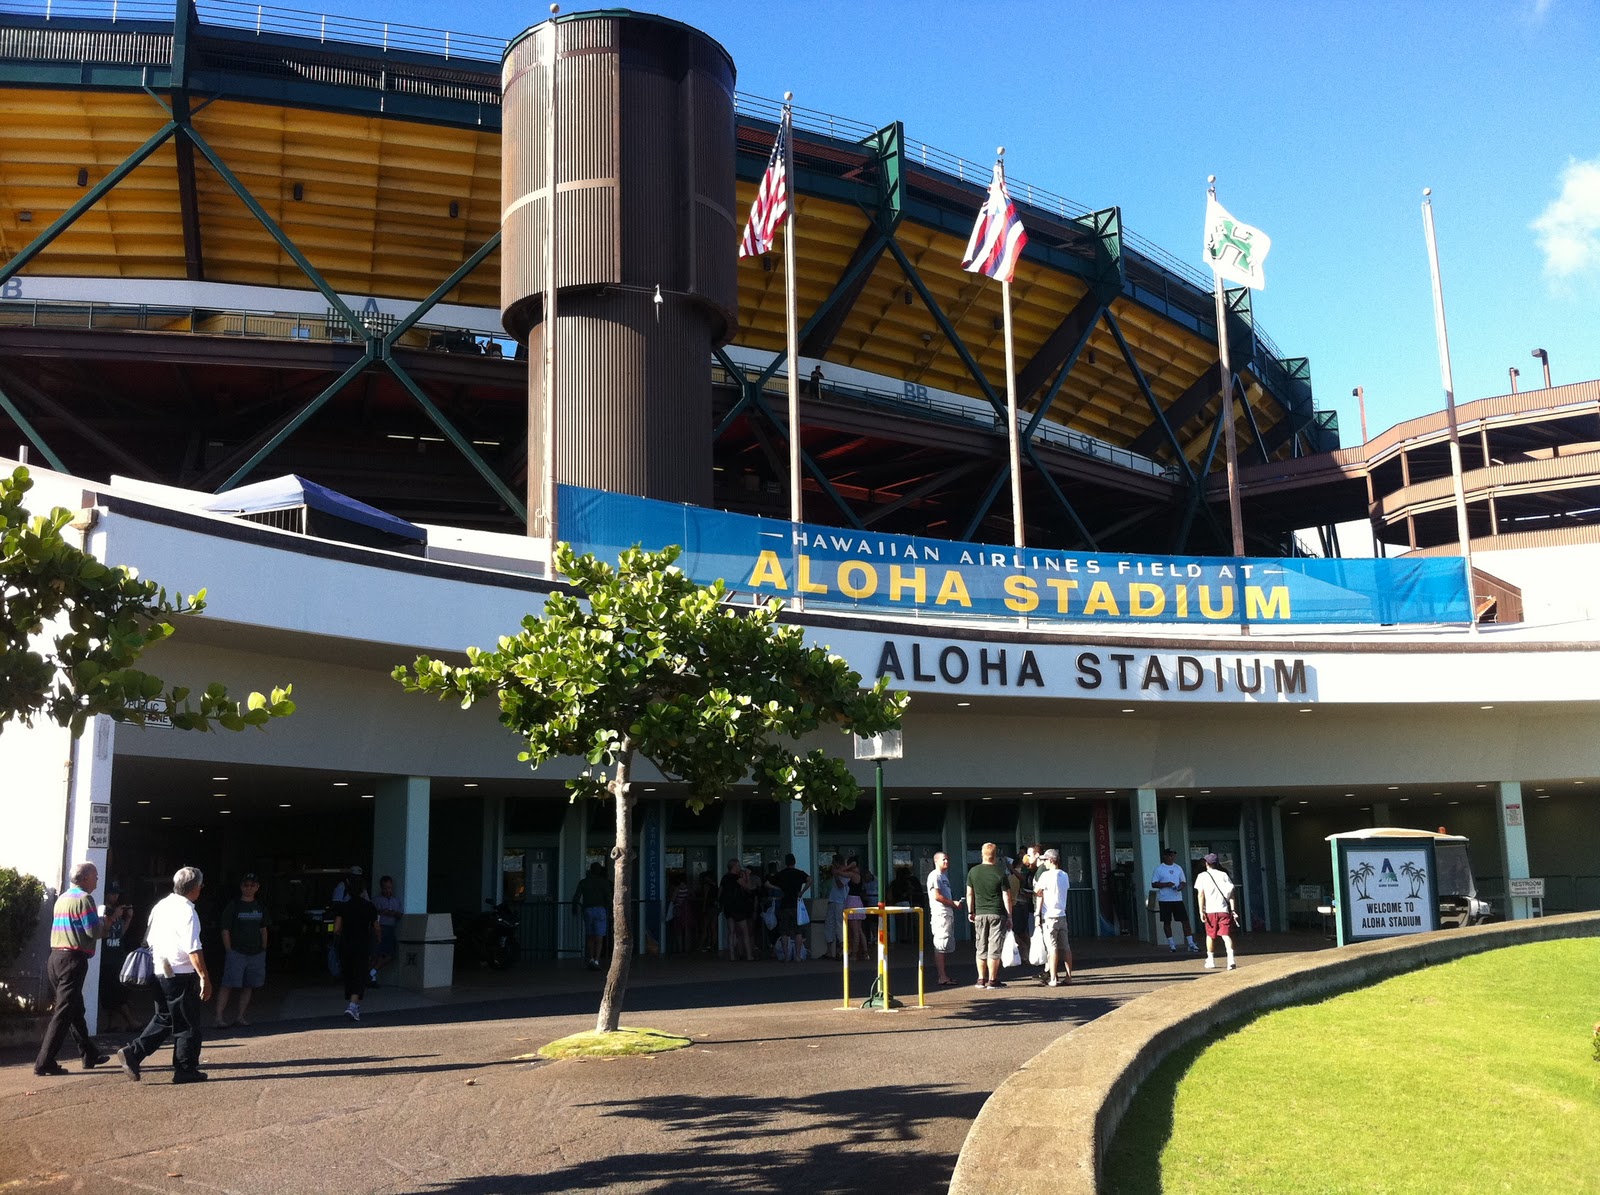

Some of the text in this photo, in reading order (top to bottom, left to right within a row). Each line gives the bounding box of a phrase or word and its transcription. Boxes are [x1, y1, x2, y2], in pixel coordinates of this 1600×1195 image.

[2, 278, 22, 299] B
[904, 382, 928, 404] BB
[792, 530, 1254, 579] HAWAIIAN AIRLINES FIELD AT
[747, 549, 1291, 620] ALOHA STADIUM
[875, 640, 1307, 694] ALOHA STADIUM
[648, 826, 657, 845] NFC
[1098, 824, 1106, 841] AFC
[1366, 902, 1414, 914] WELCOME TO
[1362, 915, 1422, 929] ALOHA STADIUM
